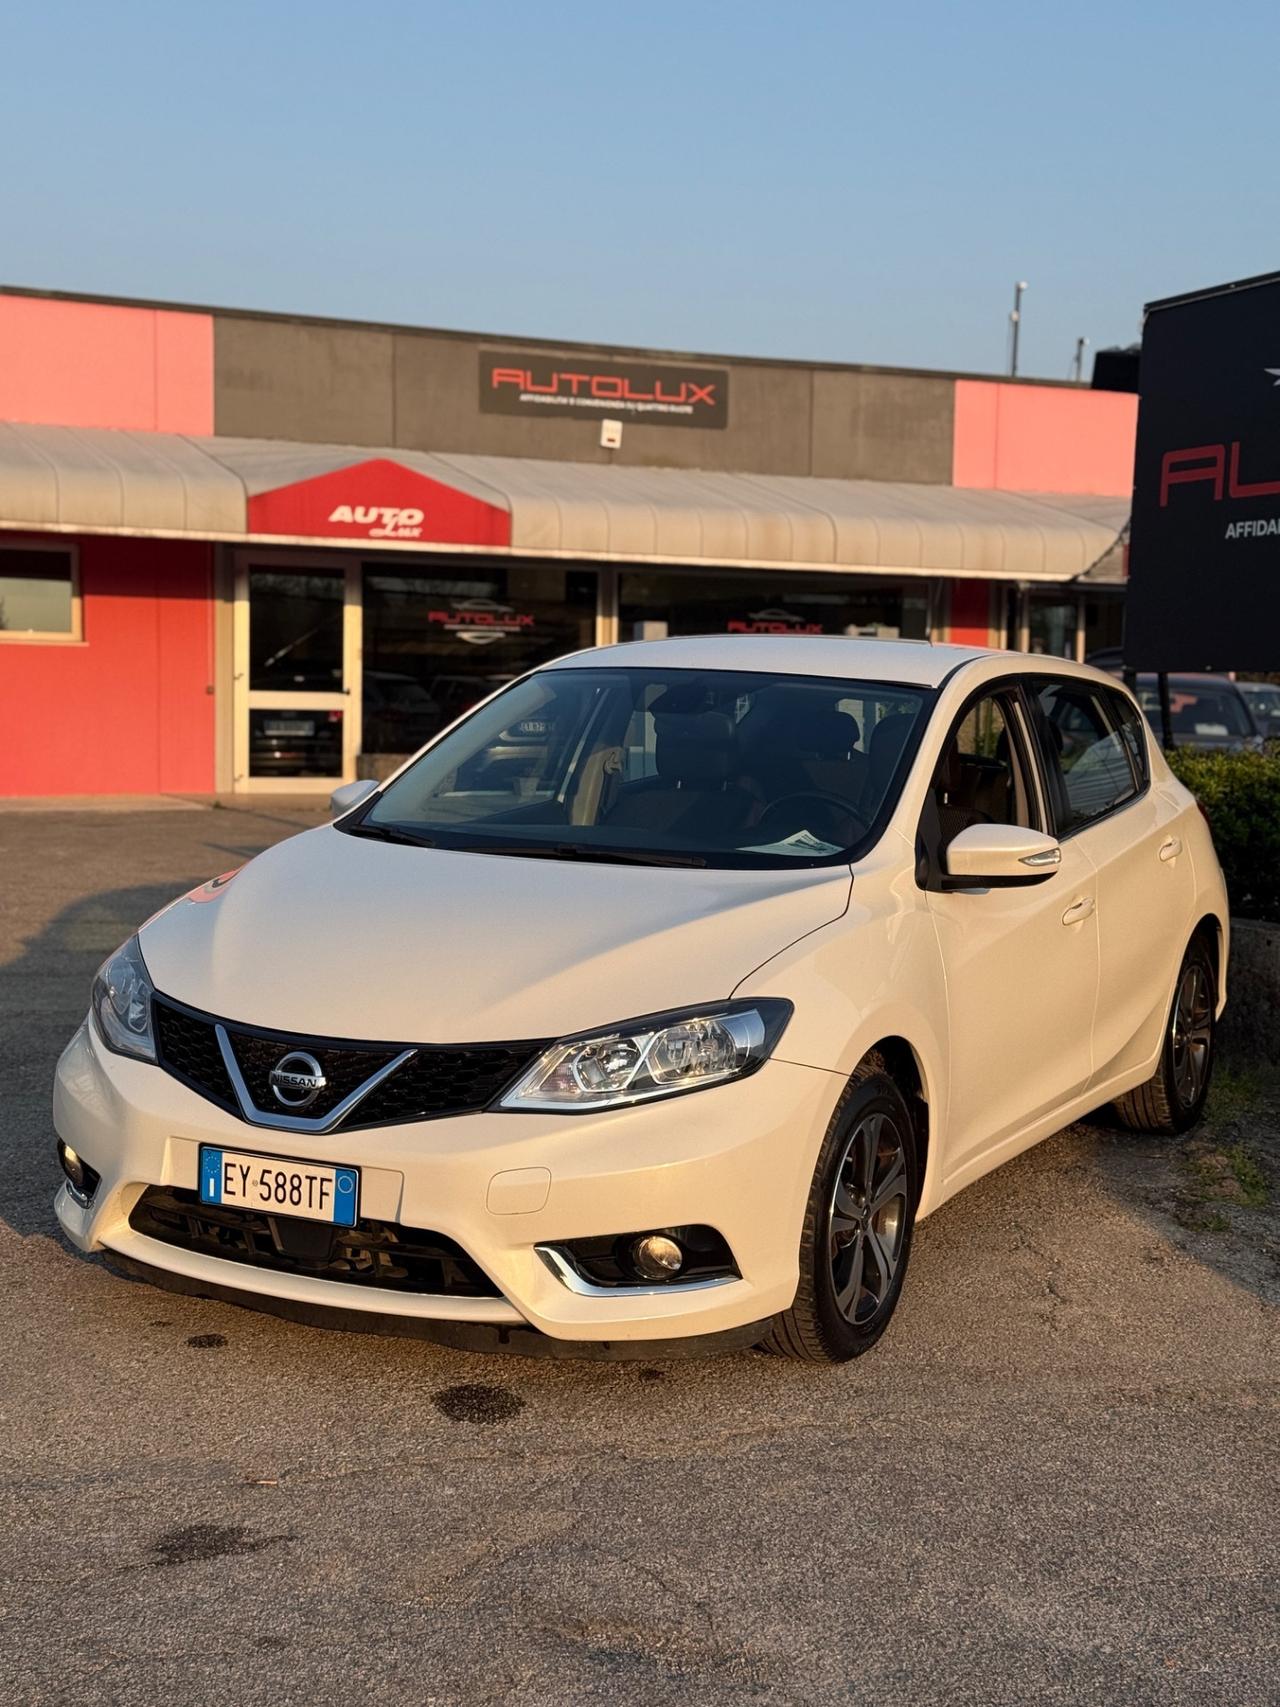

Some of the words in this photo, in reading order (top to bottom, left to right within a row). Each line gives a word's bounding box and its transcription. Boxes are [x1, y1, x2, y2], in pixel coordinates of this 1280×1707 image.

[491, 367, 716, 407] AUTOLUX
[328, 504, 425, 526] AUTO
[1224, 518, 1280, 540] AFFIDA
[427, 610, 535, 627] AUTOLUX
[271, 1072, 318, 1088] NISSAN
[223, 1162, 251, 1198] EY
[259, 1168, 333, 1210] 588TF
